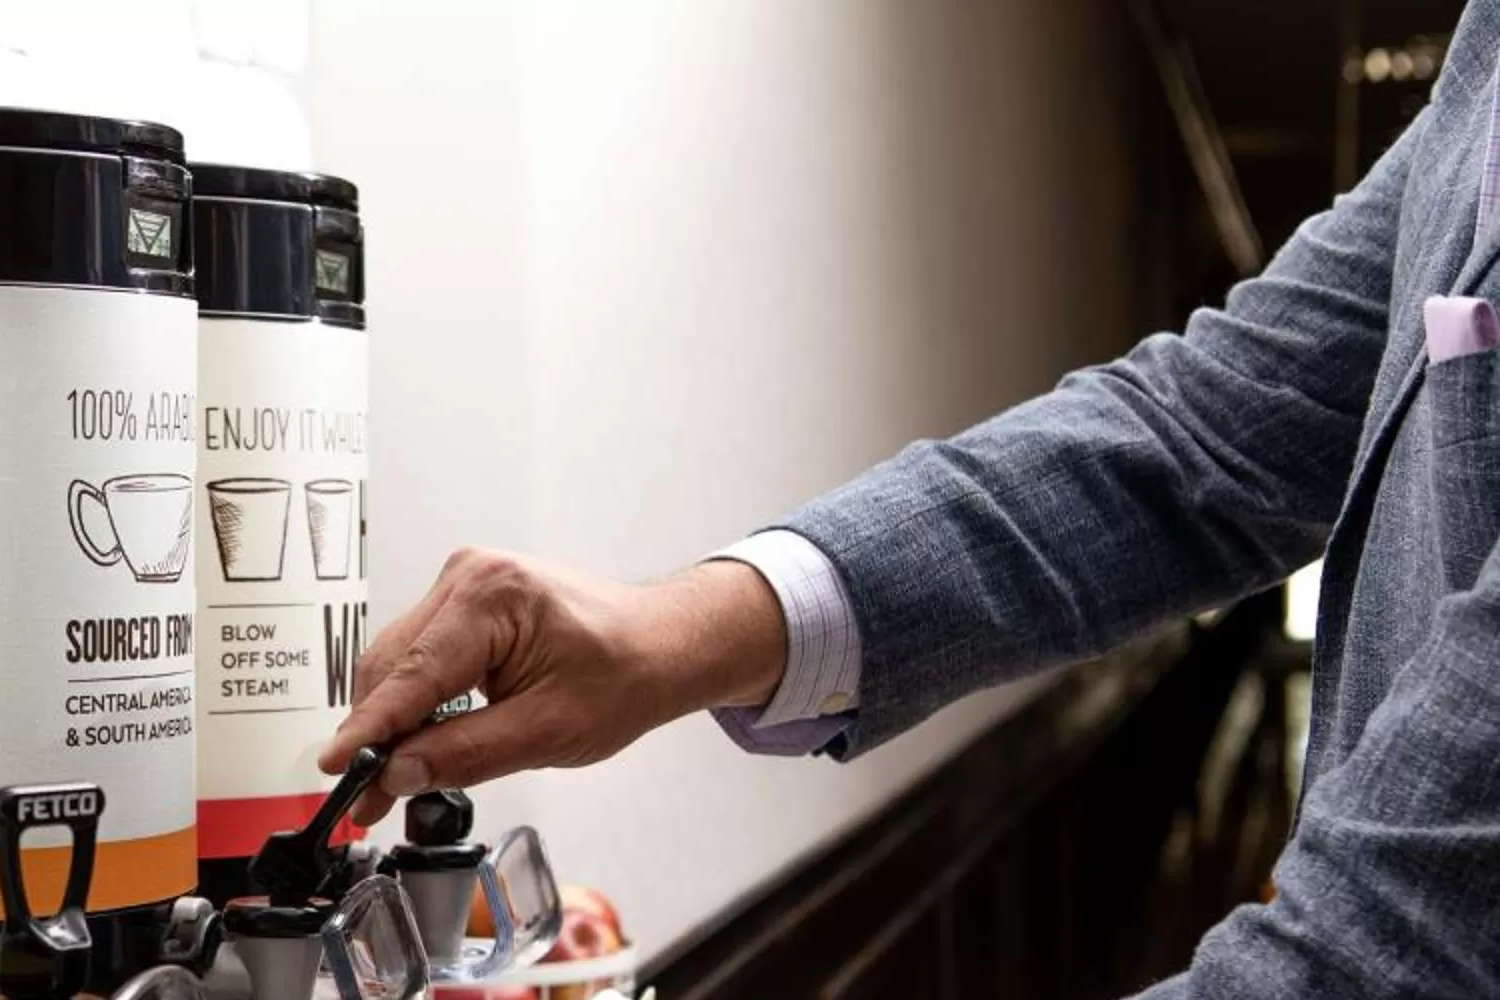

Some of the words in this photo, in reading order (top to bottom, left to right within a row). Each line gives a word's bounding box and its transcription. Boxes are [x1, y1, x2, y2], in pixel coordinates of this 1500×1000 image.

[67, 388, 137, 442] 100%
[205, 407, 290, 453] ENJOY
[299, 408, 316, 453] IT
[65, 615, 161, 663] SOURCED
[222, 624, 276, 642] BLOW
[222, 652, 260, 670] OFF
[264, 649, 309, 669] SOME
[222, 679, 288, 698] STEAM!
[65, 692, 148, 715] CENTRAL
[65, 727, 80, 747] &
[85, 722, 147, 747] SOUTH
[17, 791, 98, 822] FETCO
